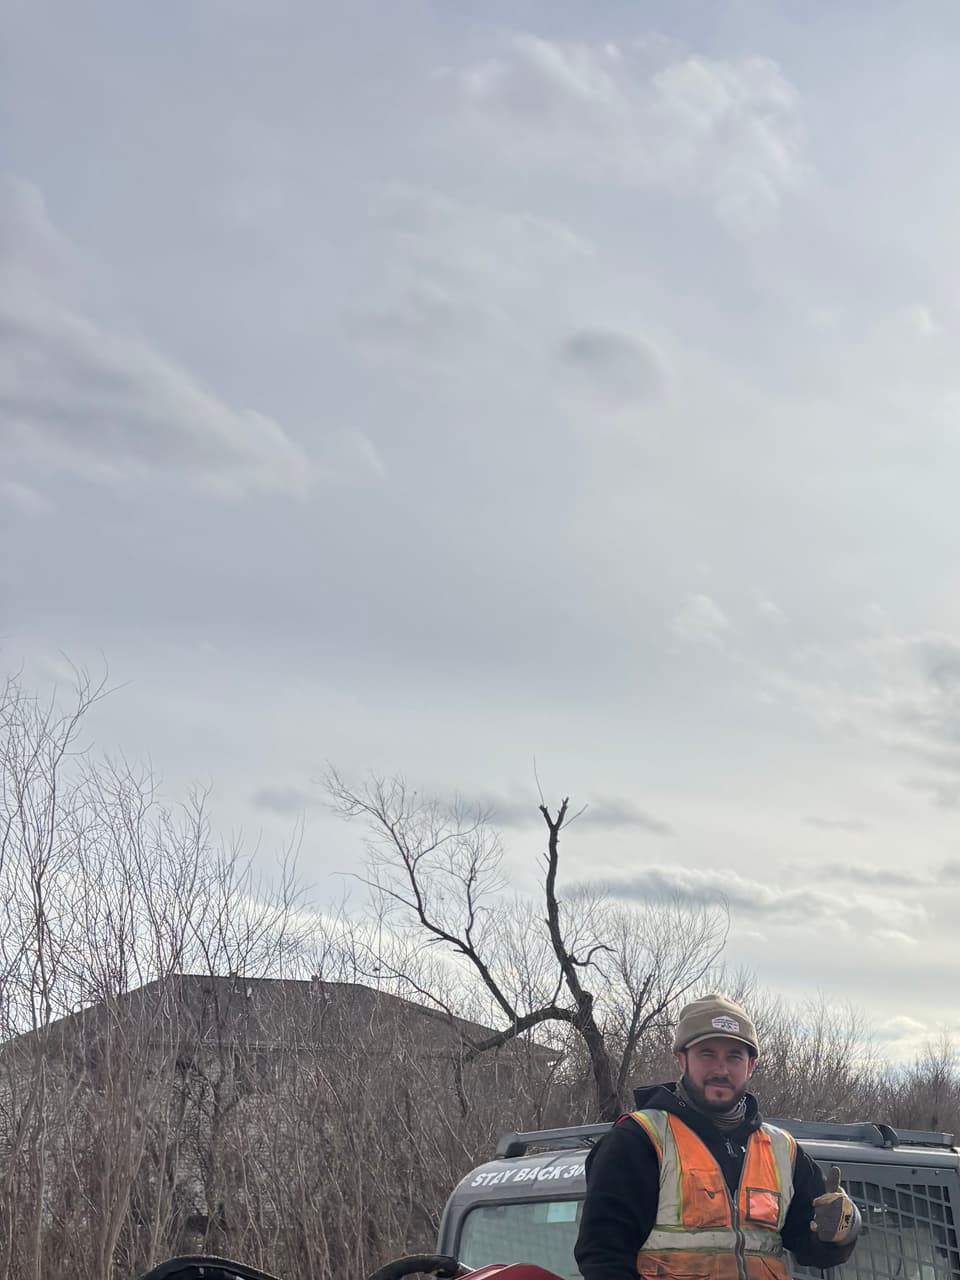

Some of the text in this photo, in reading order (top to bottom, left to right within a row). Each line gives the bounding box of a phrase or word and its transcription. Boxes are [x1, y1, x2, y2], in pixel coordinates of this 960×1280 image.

[471, 1164, 585, 1187] STAY BACK 30
